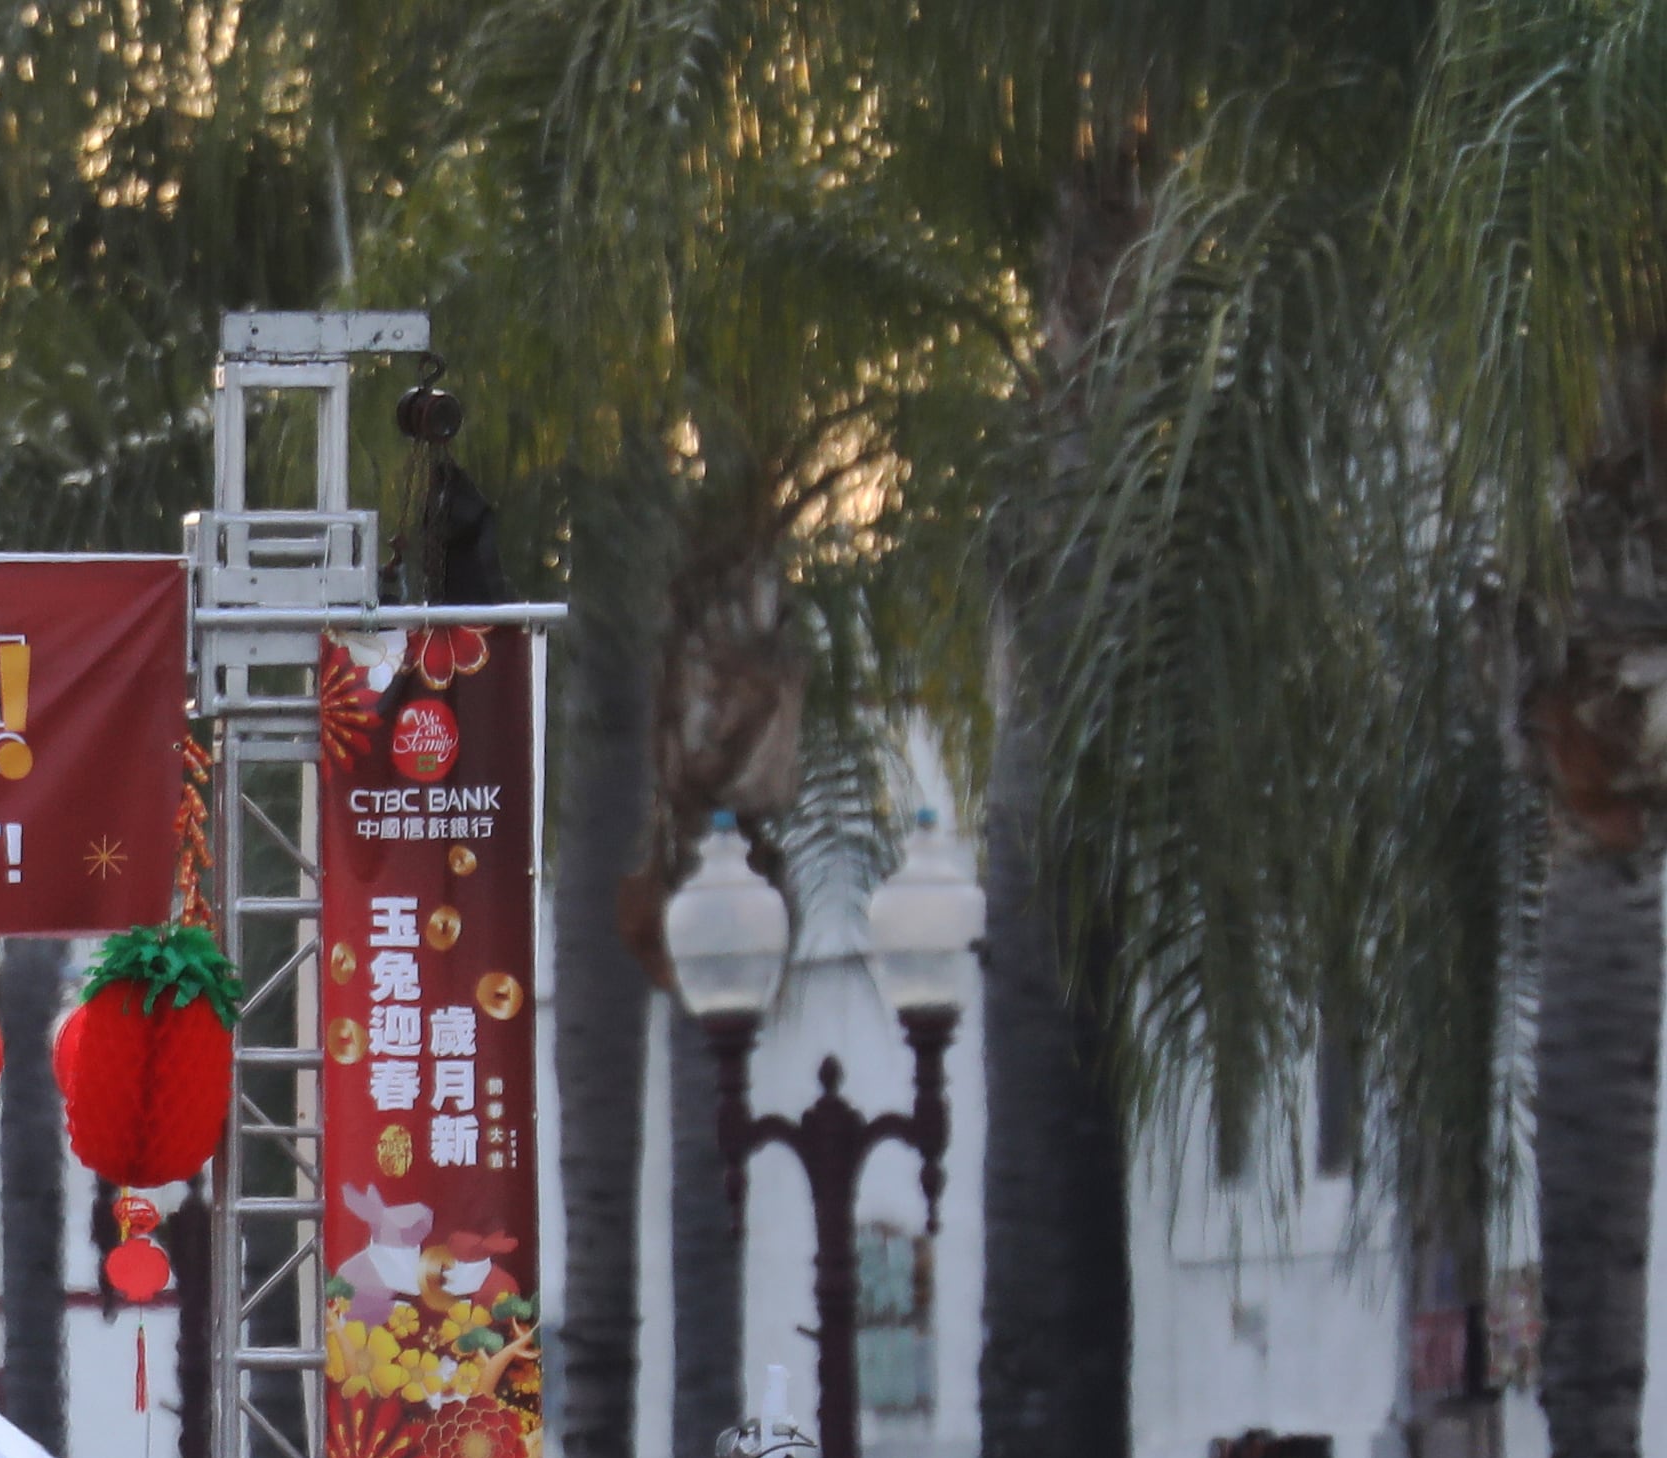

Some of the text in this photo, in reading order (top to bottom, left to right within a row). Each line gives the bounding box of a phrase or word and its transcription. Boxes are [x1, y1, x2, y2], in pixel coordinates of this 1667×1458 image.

[351, 785, 502, 814] CTBC BANK
[370, 896, 422, 1111] 玉兔迎春
[430, 1005, 479, 1168] 歲月新
